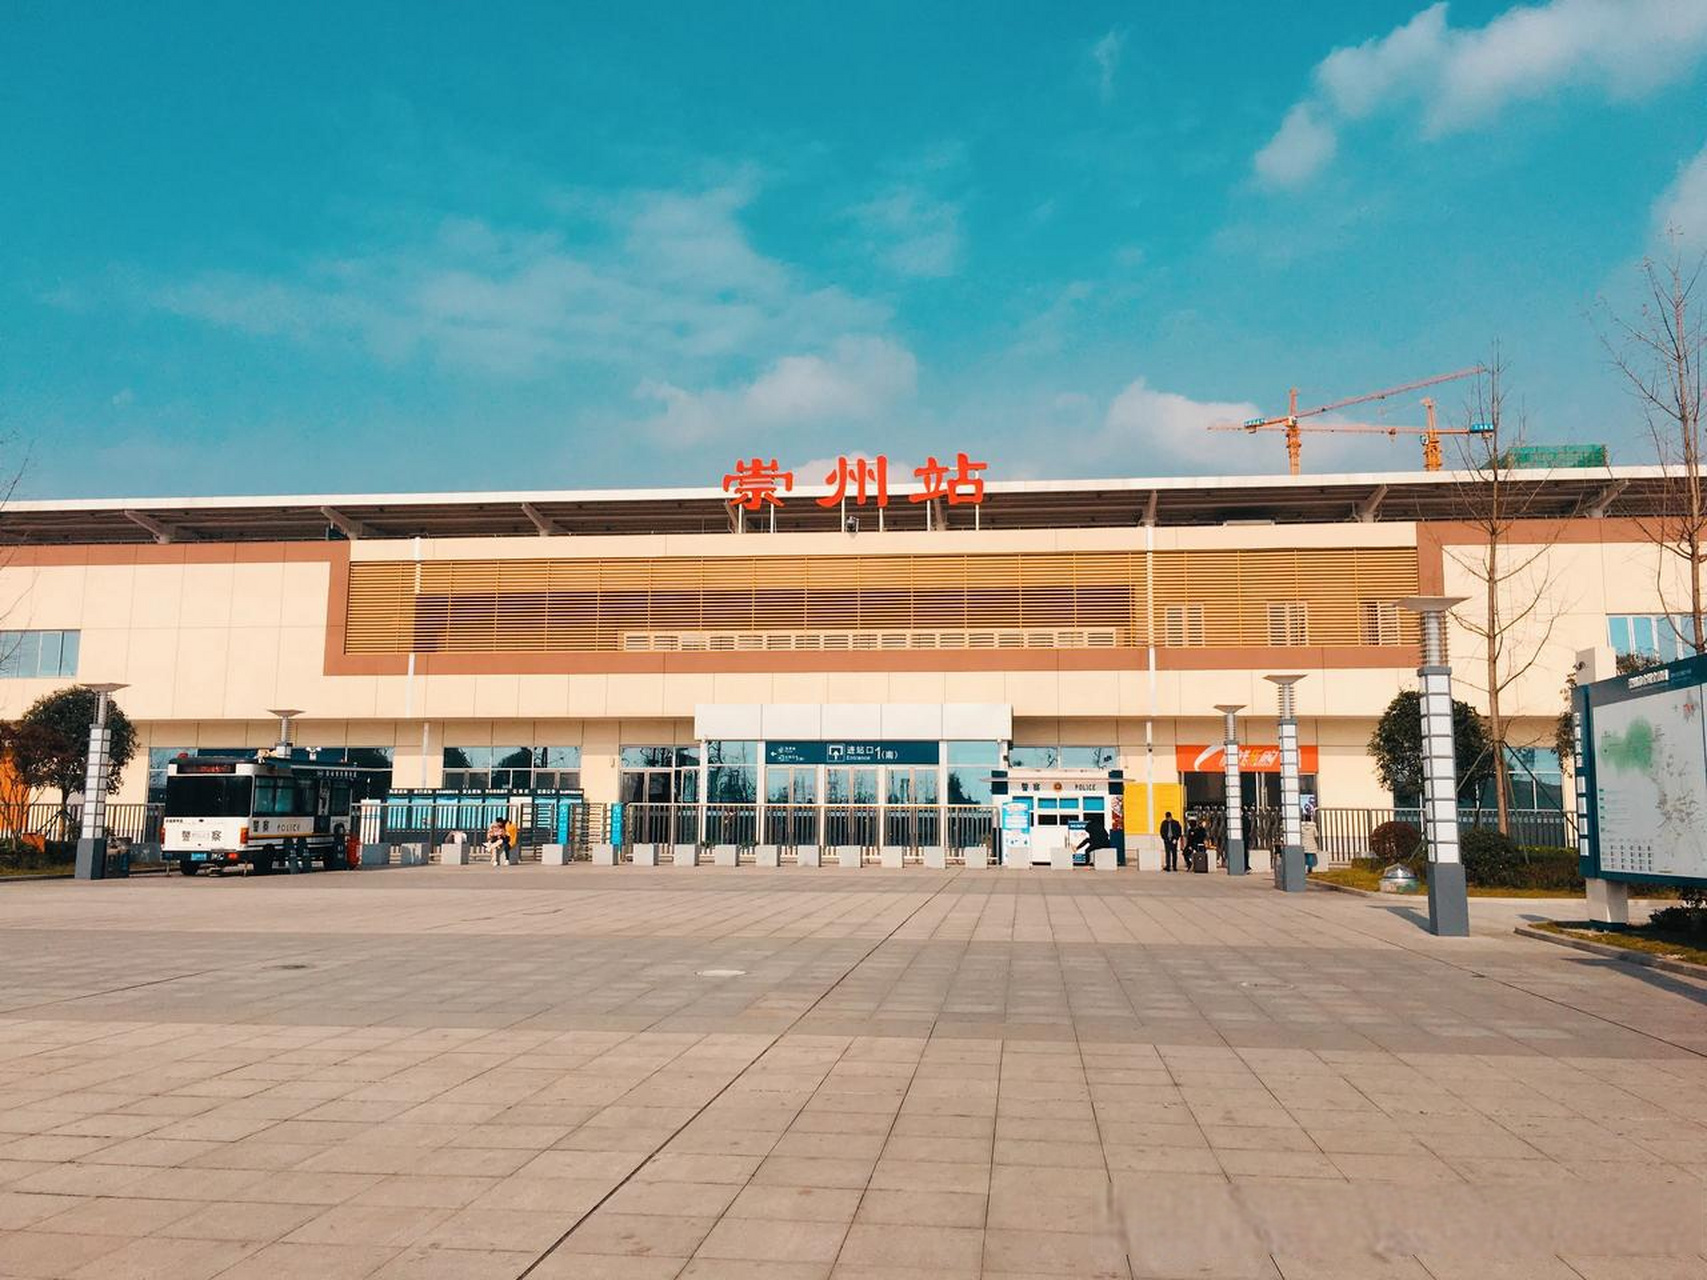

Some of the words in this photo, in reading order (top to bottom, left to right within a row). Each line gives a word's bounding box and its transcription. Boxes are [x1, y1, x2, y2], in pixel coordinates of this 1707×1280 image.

[722, 453, 988, 510] 崇州站
[1074, 783, 1096, 791] POLICE
[276, 823, 301, 832] POLICE
